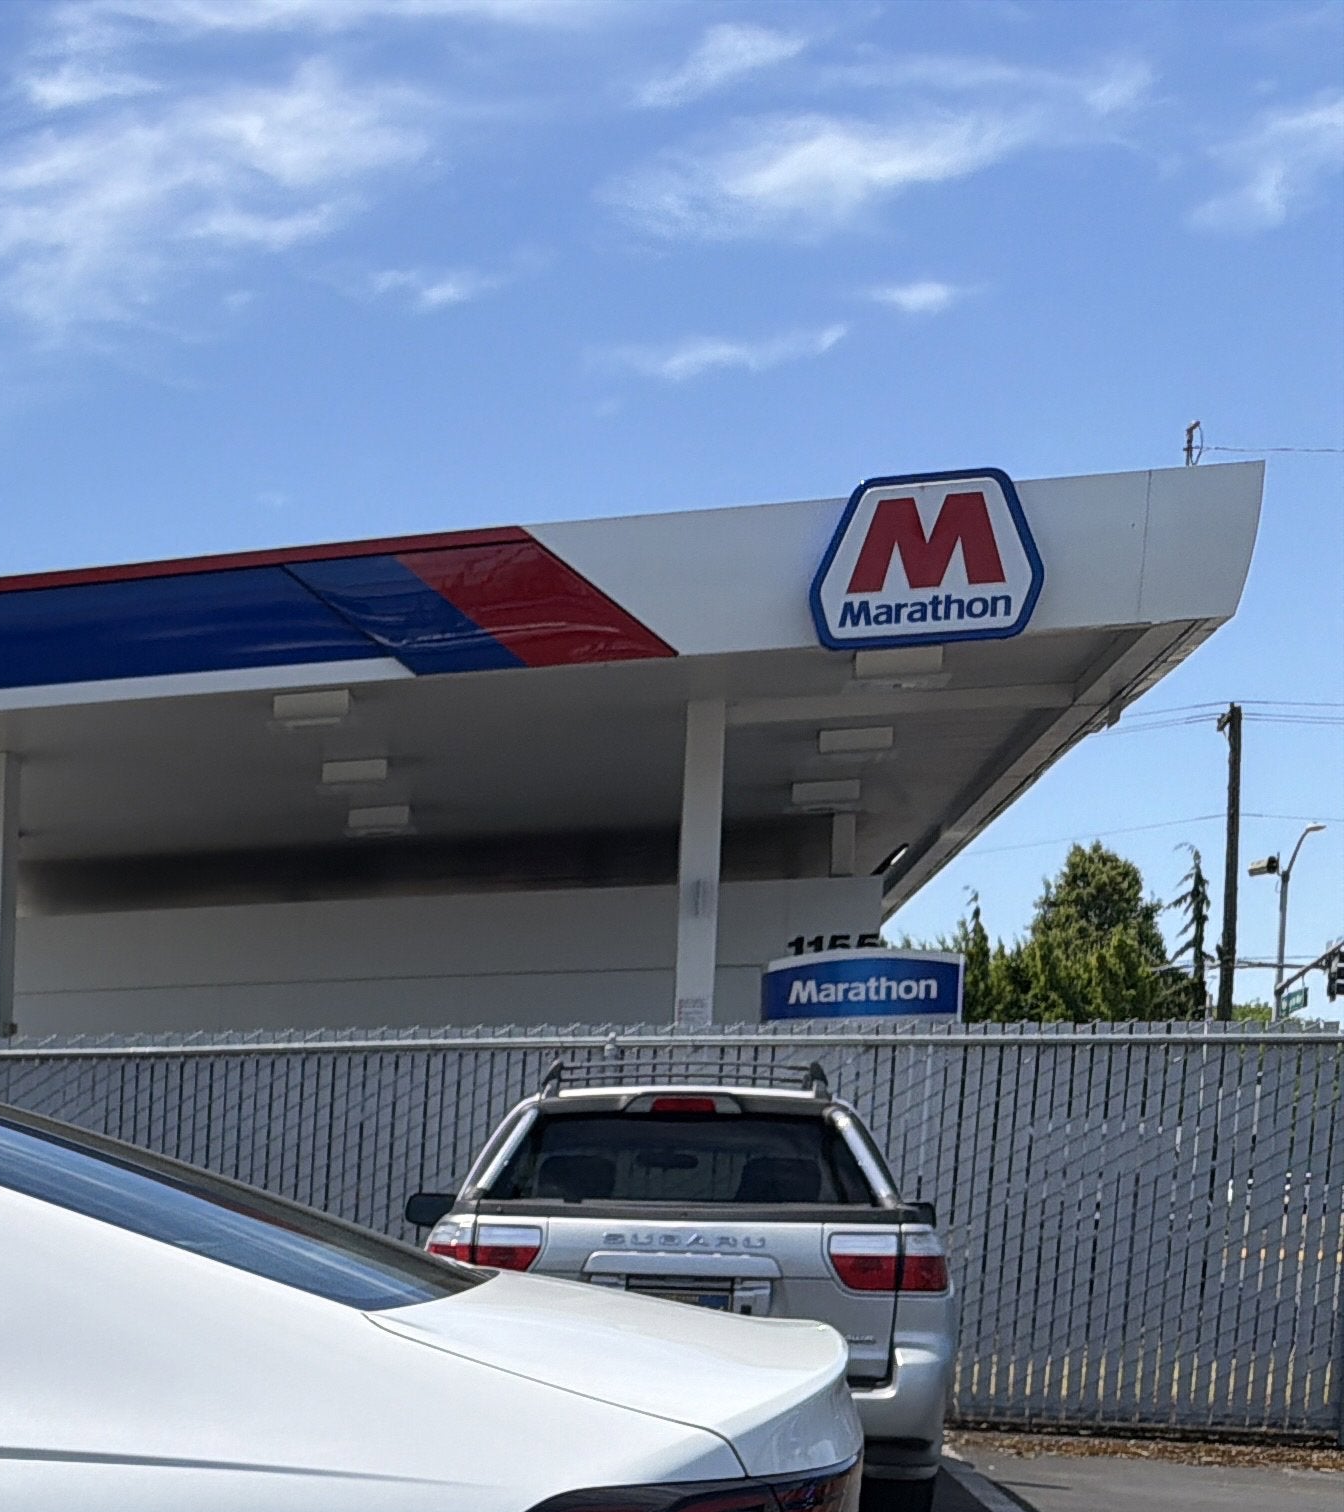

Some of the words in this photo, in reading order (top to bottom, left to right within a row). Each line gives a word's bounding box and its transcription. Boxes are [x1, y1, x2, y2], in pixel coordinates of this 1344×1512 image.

[837, 592, 1013, 630] Marathon
[787, 975, 939, 1006] Marathon
[602, 1231, 767, 1249] SUBARU
